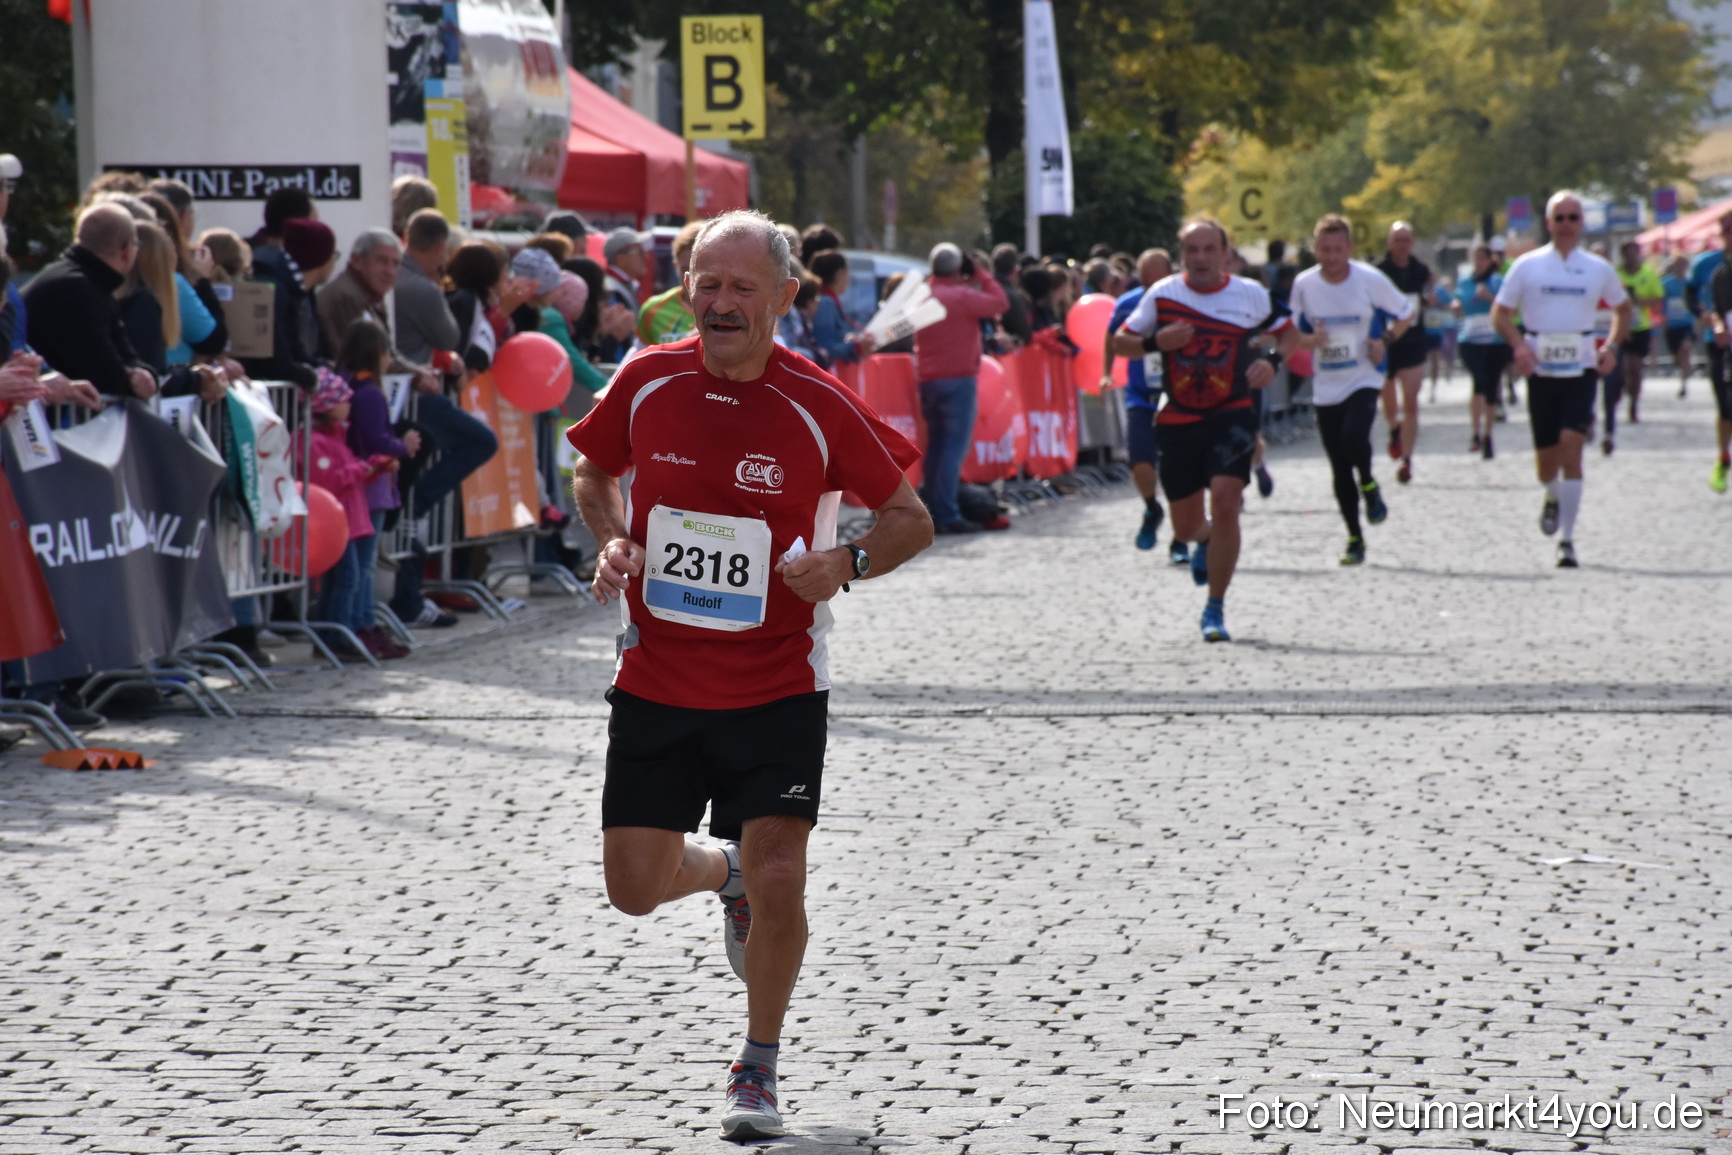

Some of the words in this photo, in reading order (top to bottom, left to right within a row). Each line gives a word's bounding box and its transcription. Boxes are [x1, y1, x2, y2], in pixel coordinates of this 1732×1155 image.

[691, 22, 753, 44] Block
[704, 54, 743, 112] B
[1240, 187, 1264, 221] C
[705, 392, 733, 404] CRAFT
[745, 453, 776, 462] Laufteam
[747, 462, 767, 475] ASV
[734, 483, 759, 493] Kraftsport
[694, 521, 737, 538] BOCK
[662, 542, 750, 588] 2318
[683, 591, 723, 610] Rudolf
